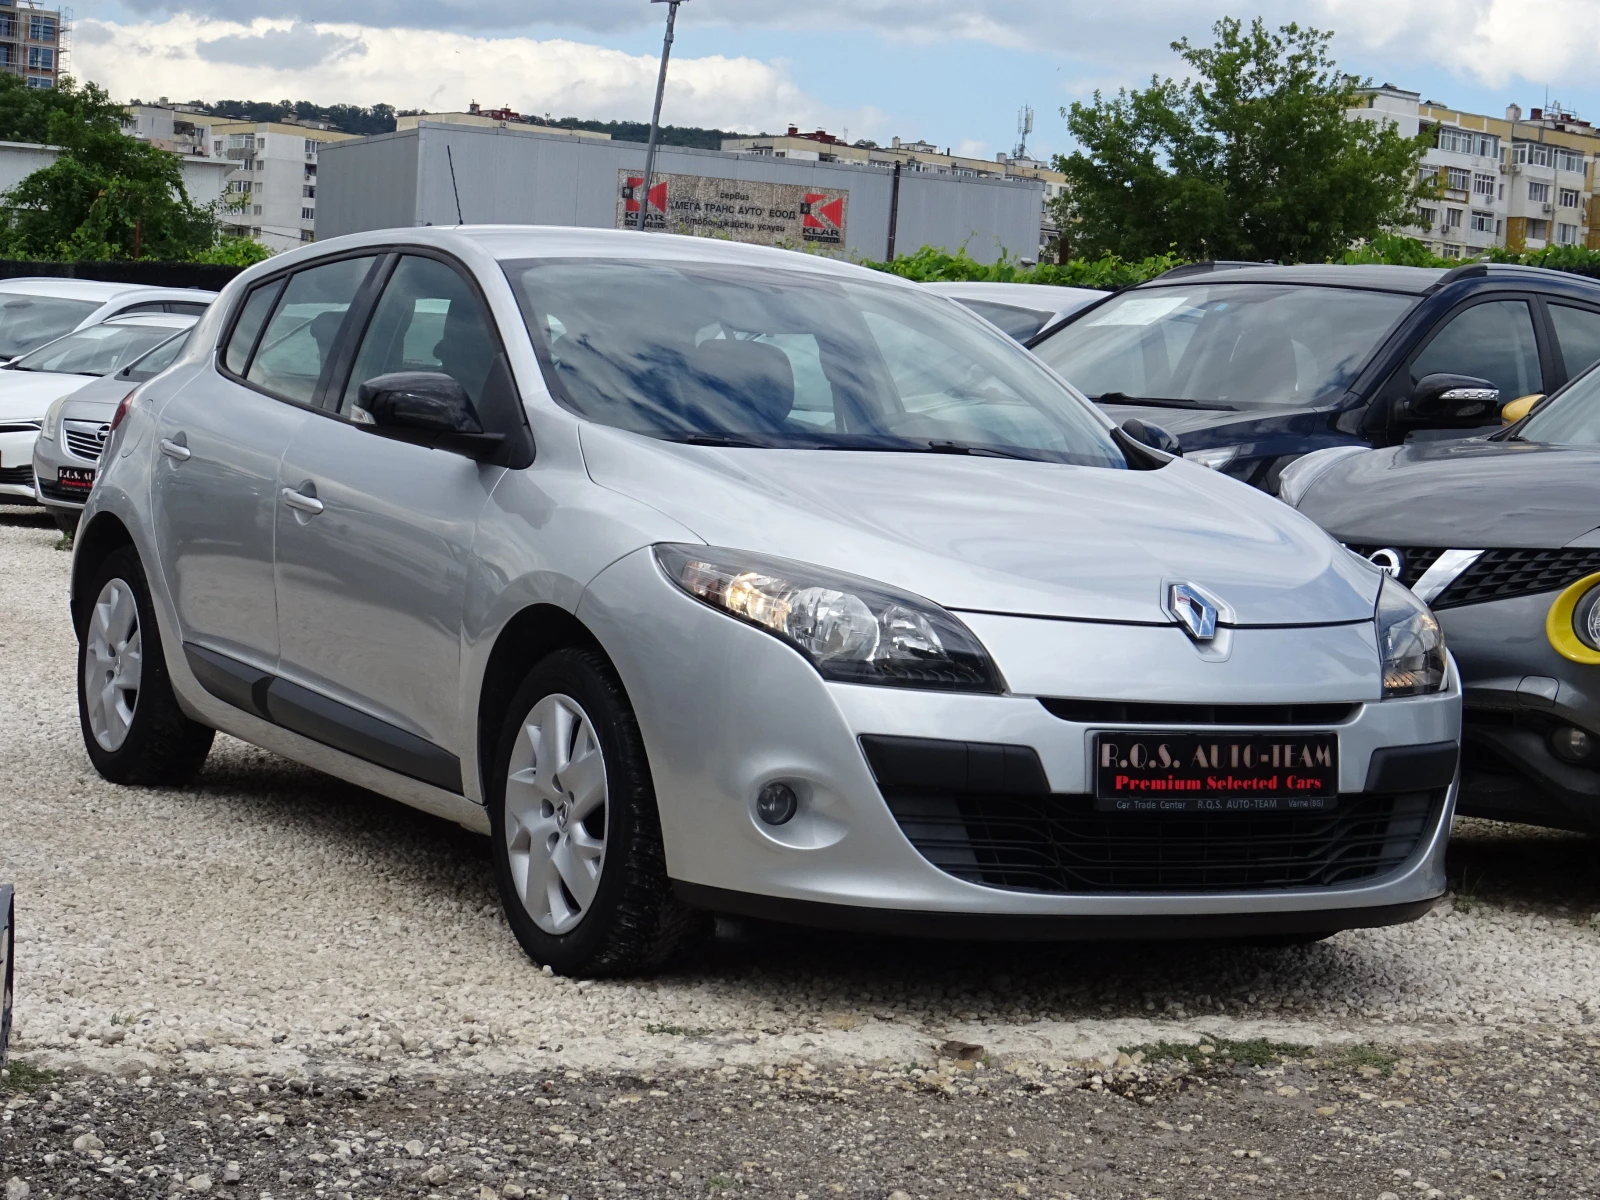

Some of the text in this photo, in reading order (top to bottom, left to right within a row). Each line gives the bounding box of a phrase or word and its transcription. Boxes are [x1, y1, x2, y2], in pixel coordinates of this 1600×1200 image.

[704, 203, 735, 214] ТРАНС
[769, 209, 796, 220] ЕООД
[802, 227, 840, 237] KLAR
[1101, 743, 1332, 770] R.Q.S. AUTO-TEAM
[1115, 774, 1322, 790] Premium Selected Cars
[1116, 801, 1130, 809] Car
[1134, 801, 1156, 809] Trade
[1160, 801, 1186, 809] Center
